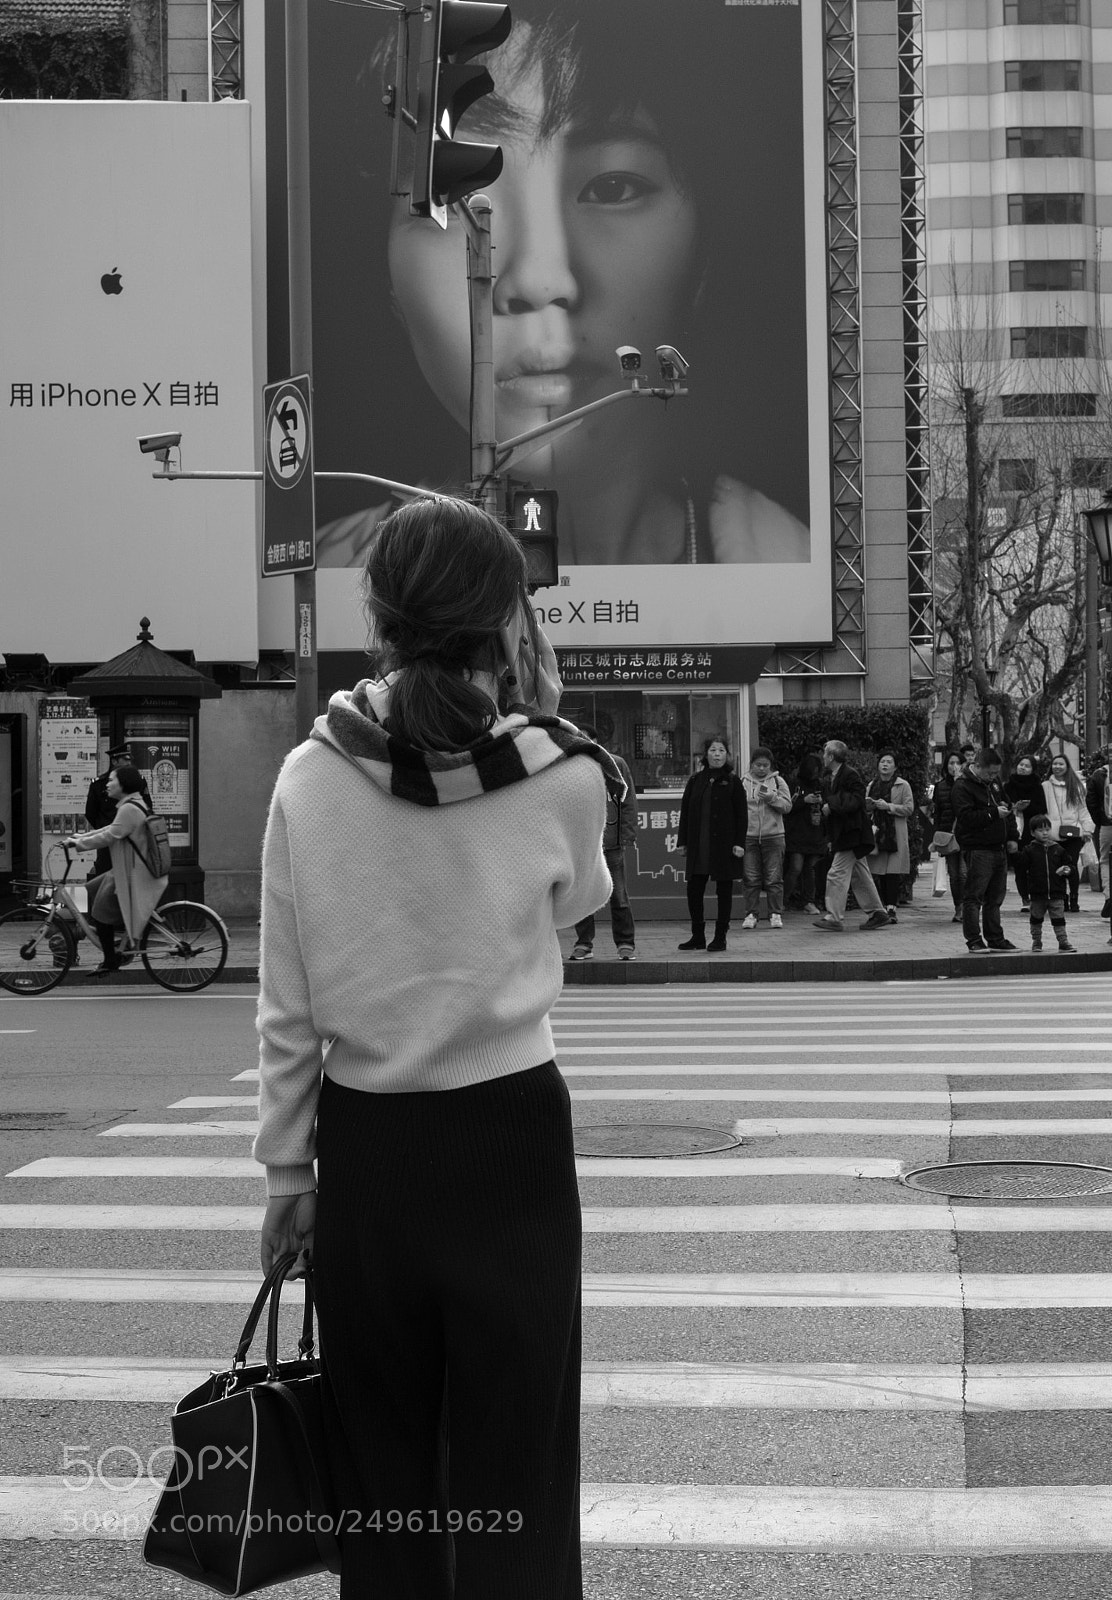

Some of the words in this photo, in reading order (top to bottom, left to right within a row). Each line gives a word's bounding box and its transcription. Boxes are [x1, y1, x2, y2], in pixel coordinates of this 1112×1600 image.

[10, 383, 33, 407] 用
[41, 383, 137, 407] iPhone
[143, 383, 162, 406] X
[169, 381, 220, 407] 自拍
[568, 601, 586, 624] X
[593, 599, 639, 624] 自拍
[557, 653, 712, 667] 浦区城市志愿服务站
[559, 670, 609, 680] lunteer
[613, 669, 663, 680] Service
[666, 669, 713, 680] Center
